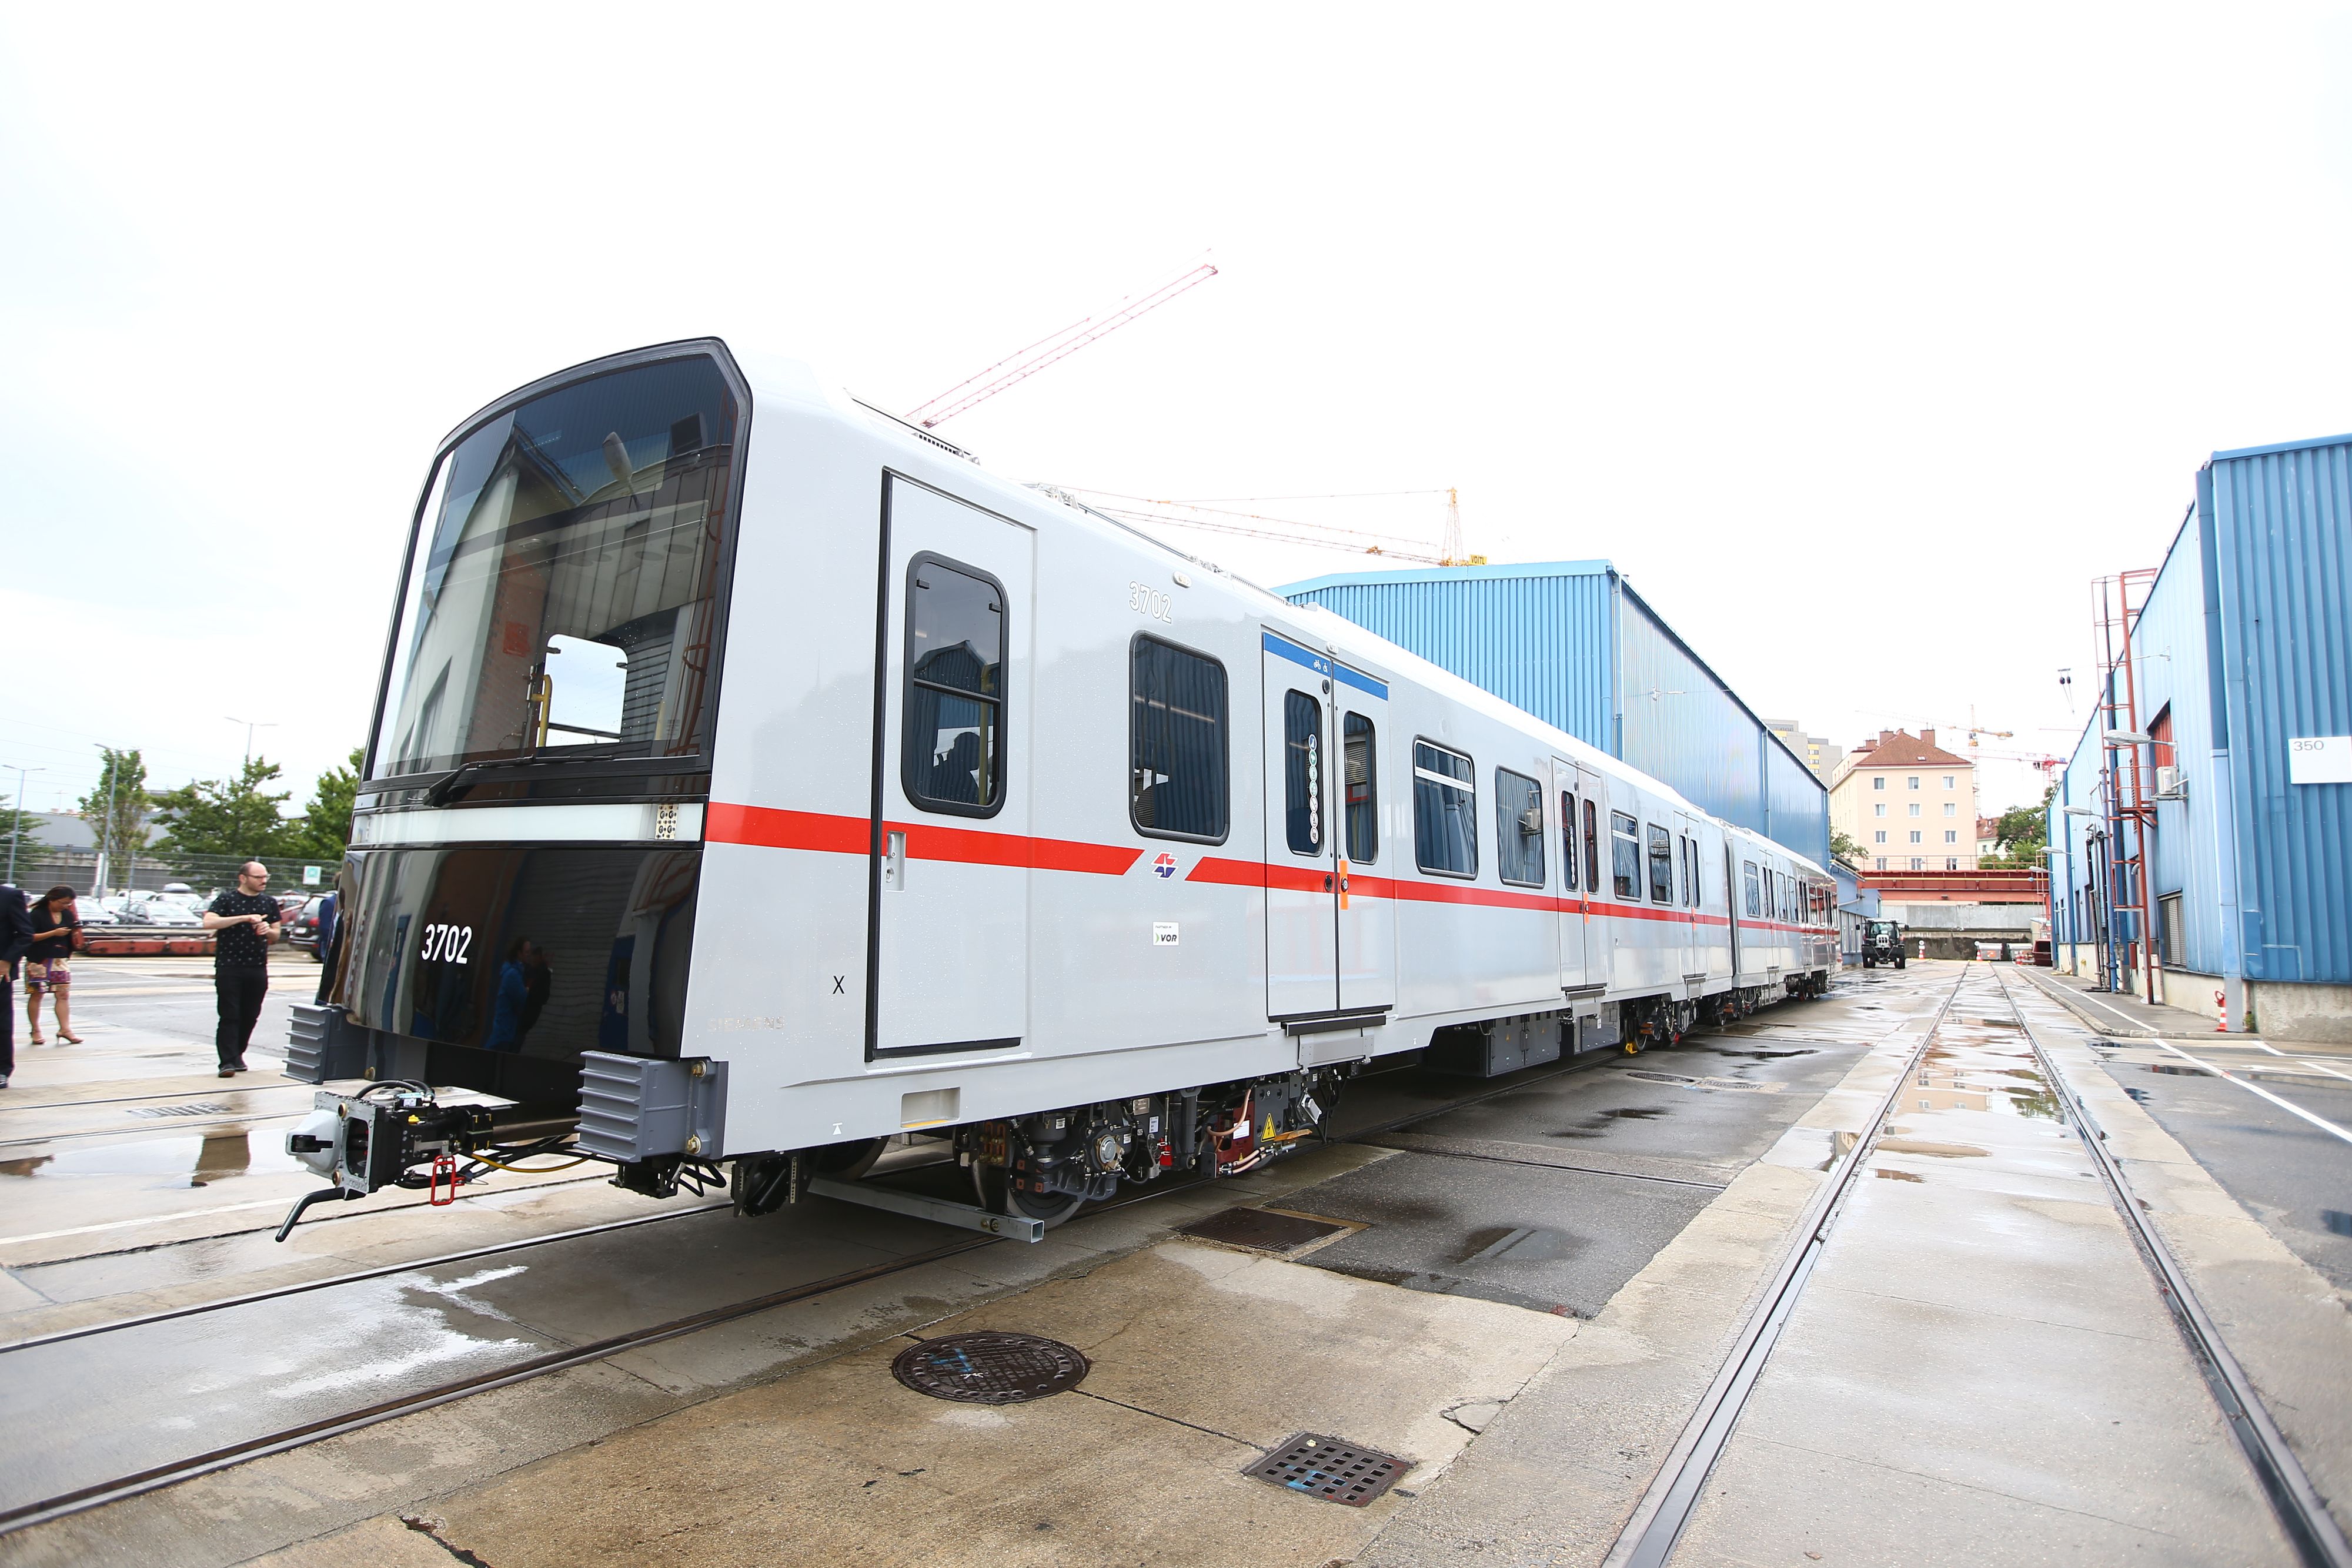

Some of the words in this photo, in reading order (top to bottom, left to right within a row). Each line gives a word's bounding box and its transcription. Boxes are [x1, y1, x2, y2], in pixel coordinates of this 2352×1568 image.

[1471, 555, 1485, 564] VOITL
[1129, 581, 1172, 624] 3702
[2293, 740, 2324, 751] 350
[422, 924, 472, 964] 3702
[833, 975, 845, 994] X
[707, 1017, 785, 1032] SIEMENS
